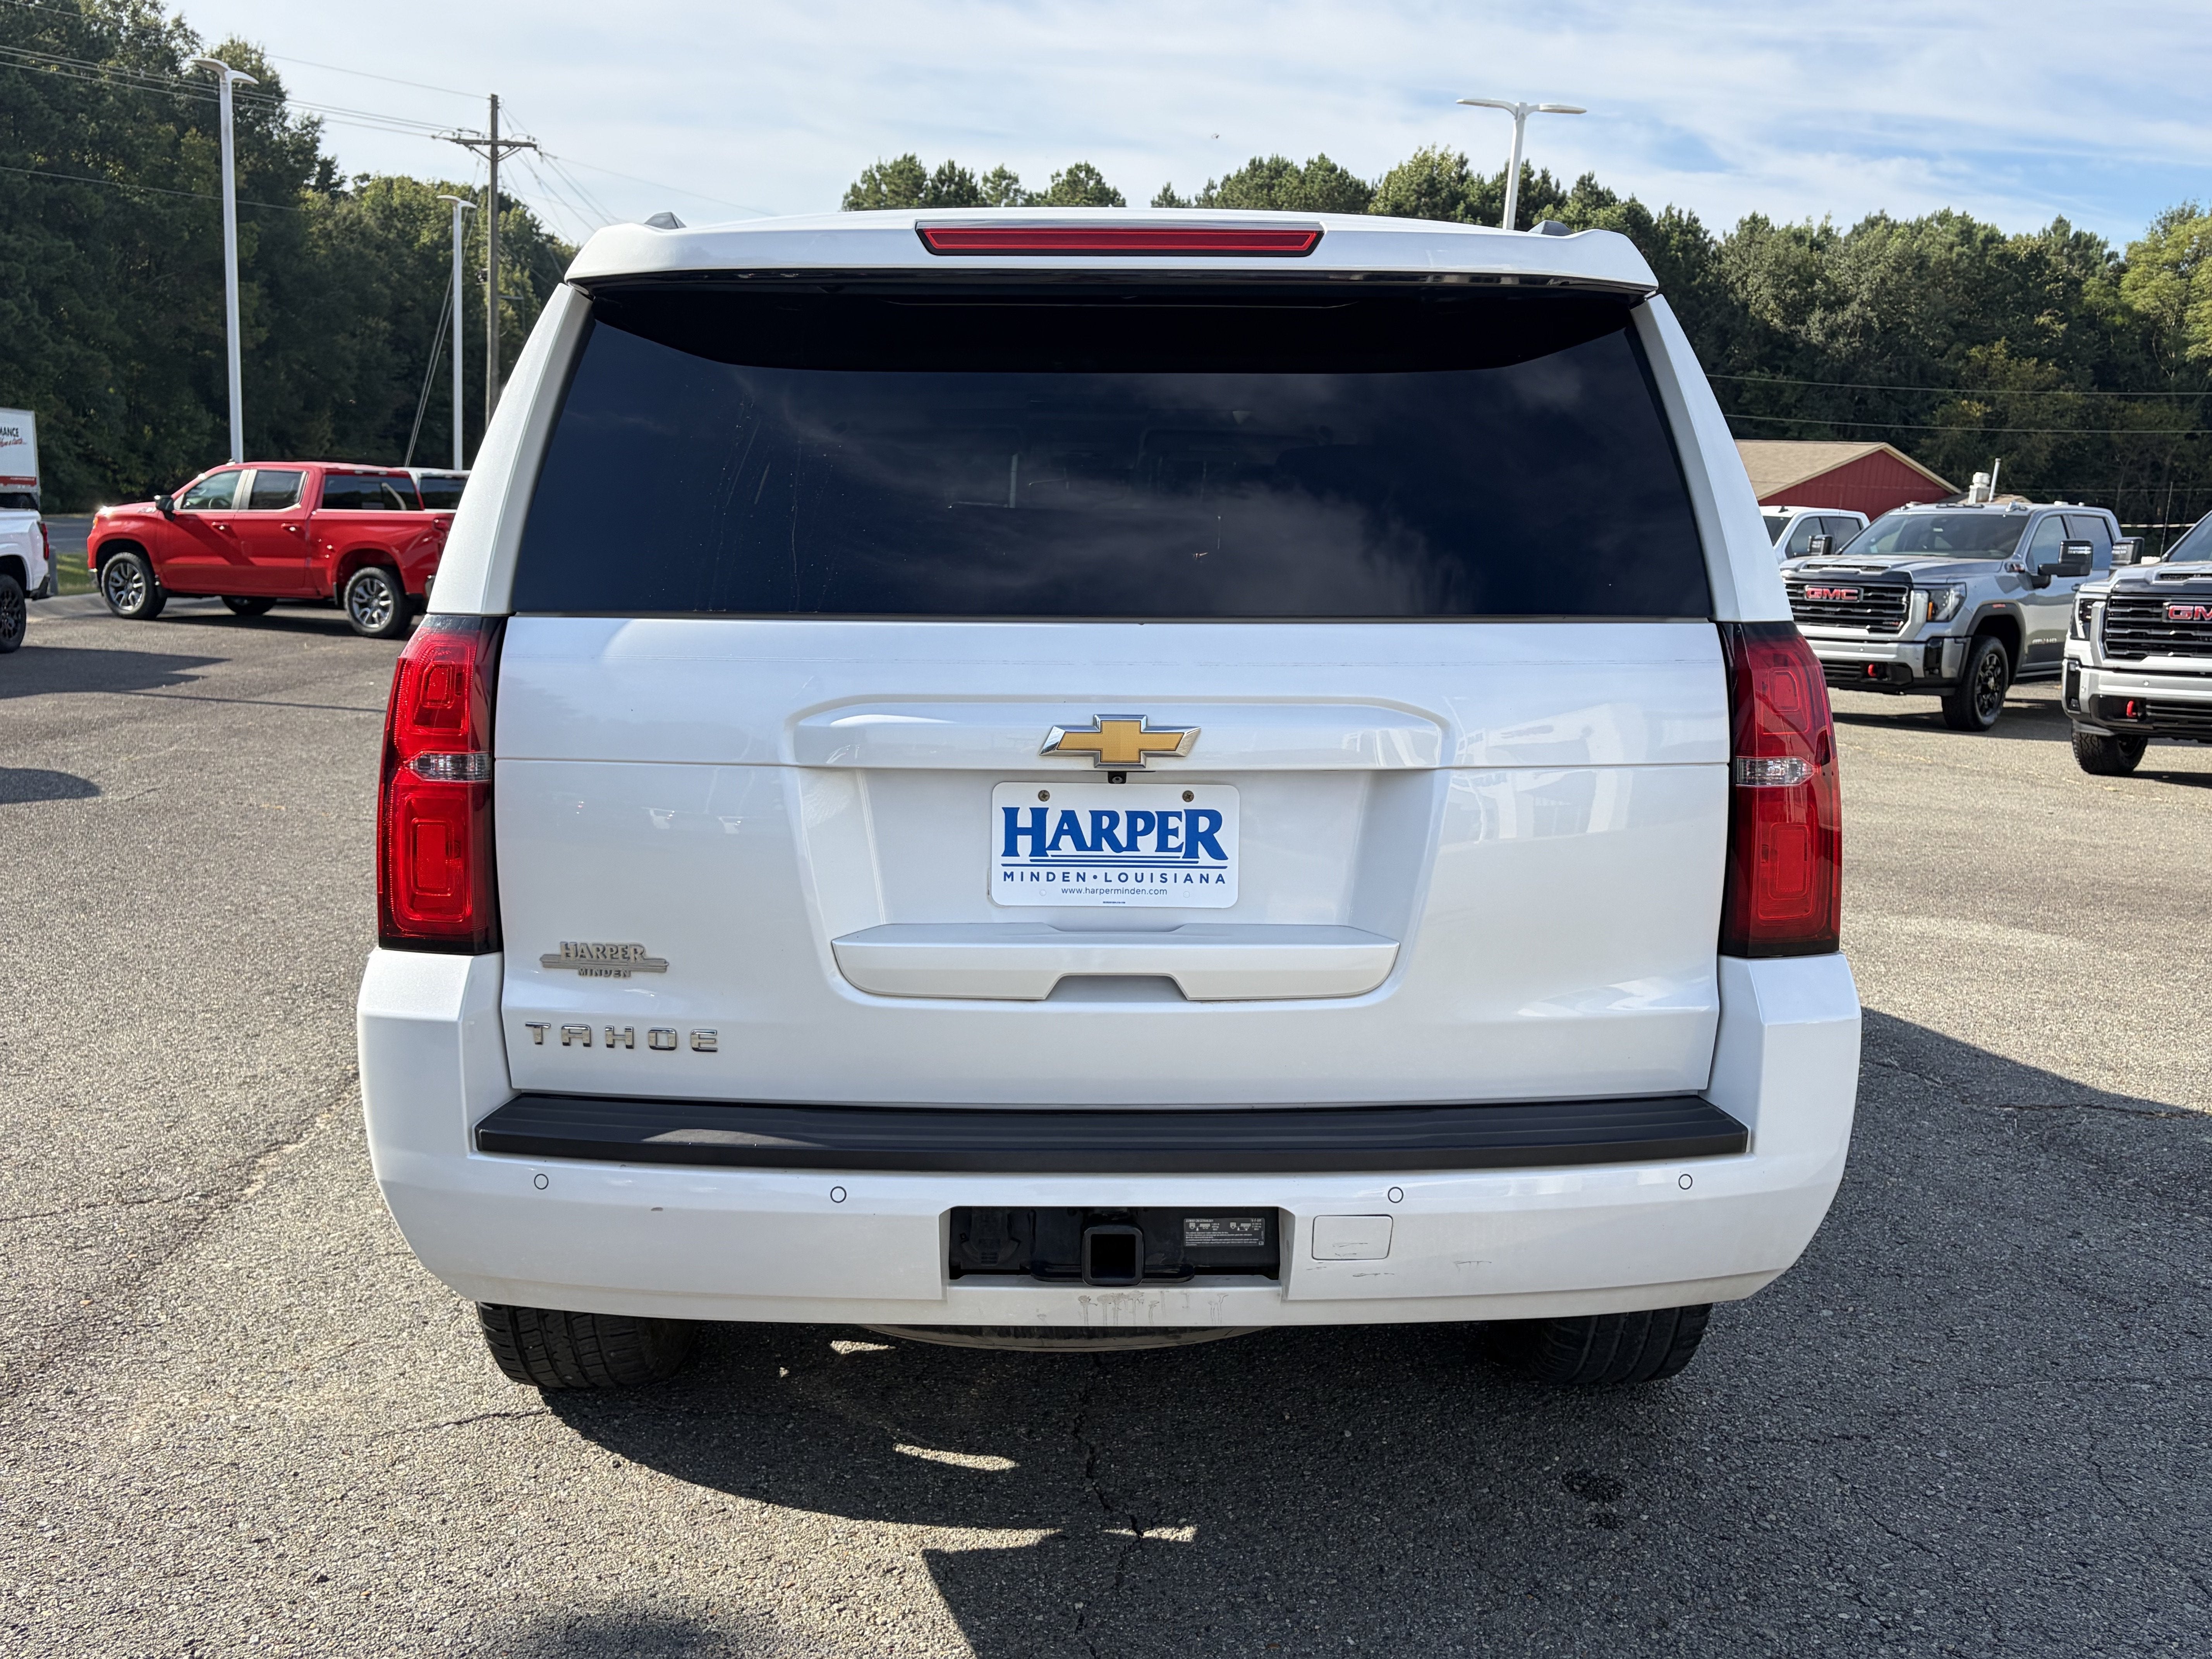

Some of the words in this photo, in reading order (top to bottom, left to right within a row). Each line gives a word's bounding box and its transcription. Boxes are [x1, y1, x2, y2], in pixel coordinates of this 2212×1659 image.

[1807, 587, 1858, 600] GMC
[1001, 807, 1229, 860] HARPER
[1061, 886, 1168, 896] www.harperminden.com
[560, 941, 646, 963] HARPER
[578, 968, 631, 977] MINDEN
[524, 1021, 718, 1053] TAHOE
